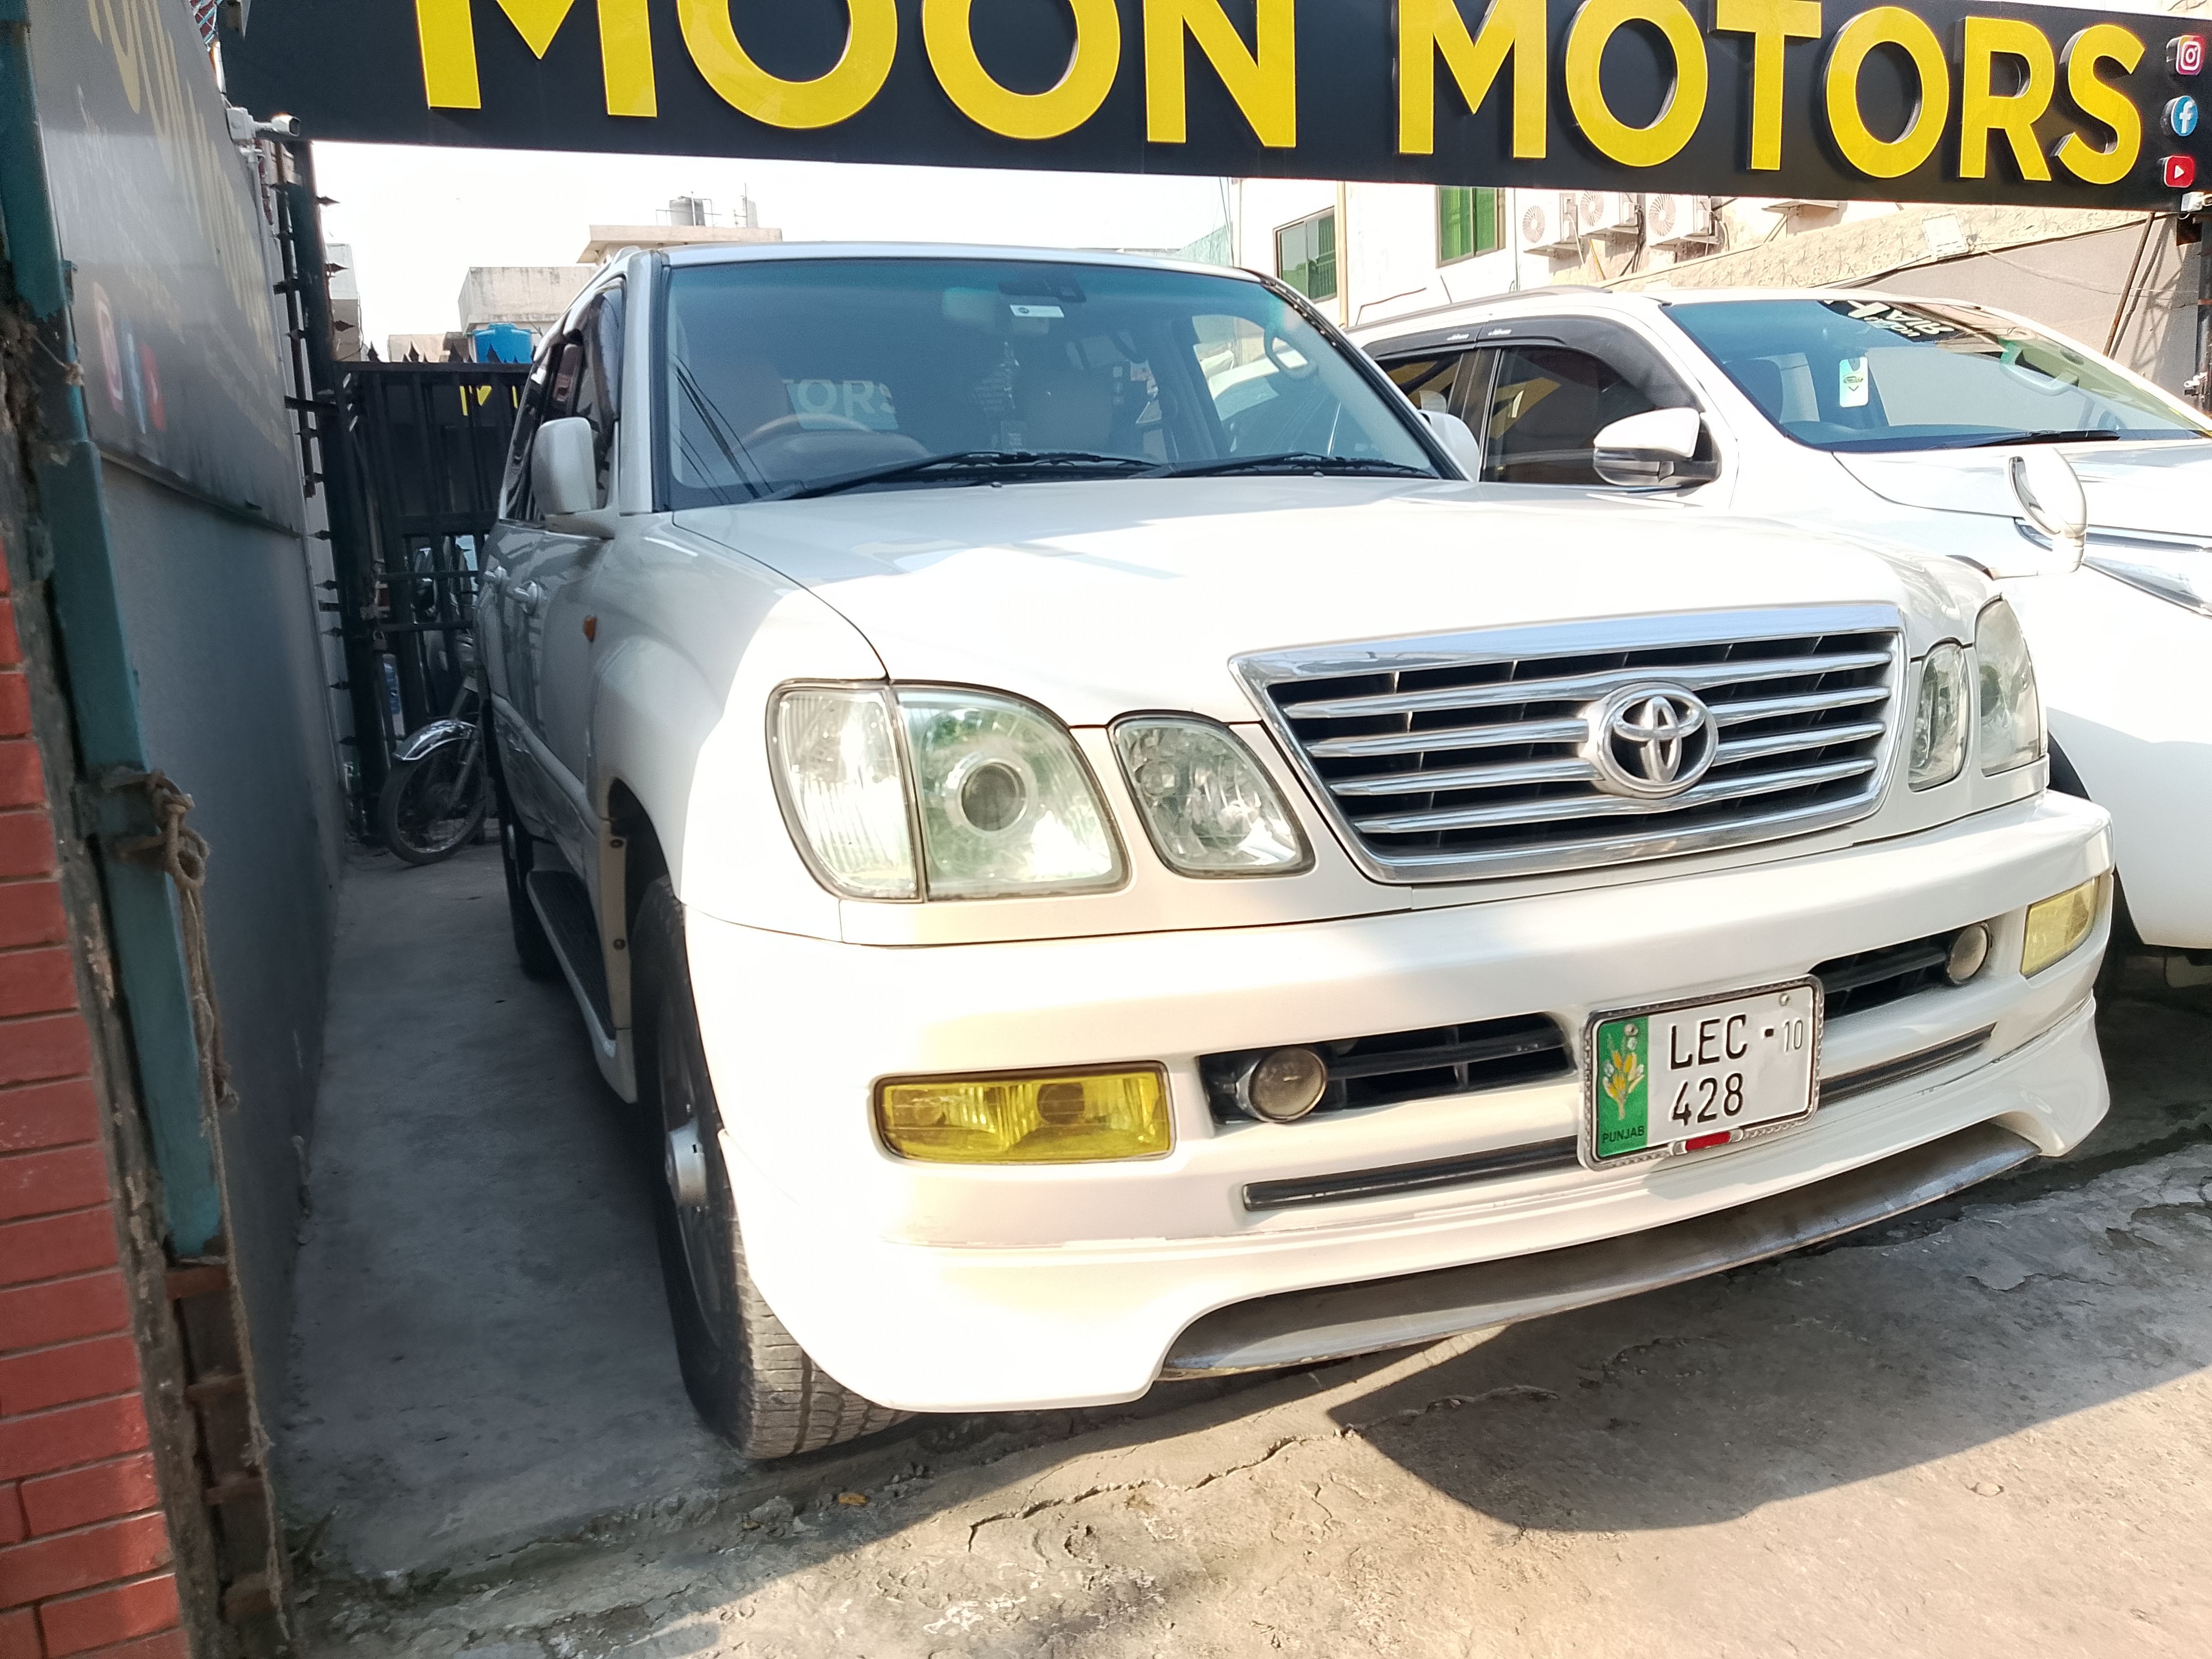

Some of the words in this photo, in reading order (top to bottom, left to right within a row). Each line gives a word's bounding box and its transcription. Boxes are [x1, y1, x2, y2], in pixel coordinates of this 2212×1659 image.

[1395, 0, 2145, 185] MOTORS
[1670, 1013, 1748, 1070] LEC
[1670, 1073, 1744, 1127] 428
[1602, 1125, 1645, 1144] PUNJAB
